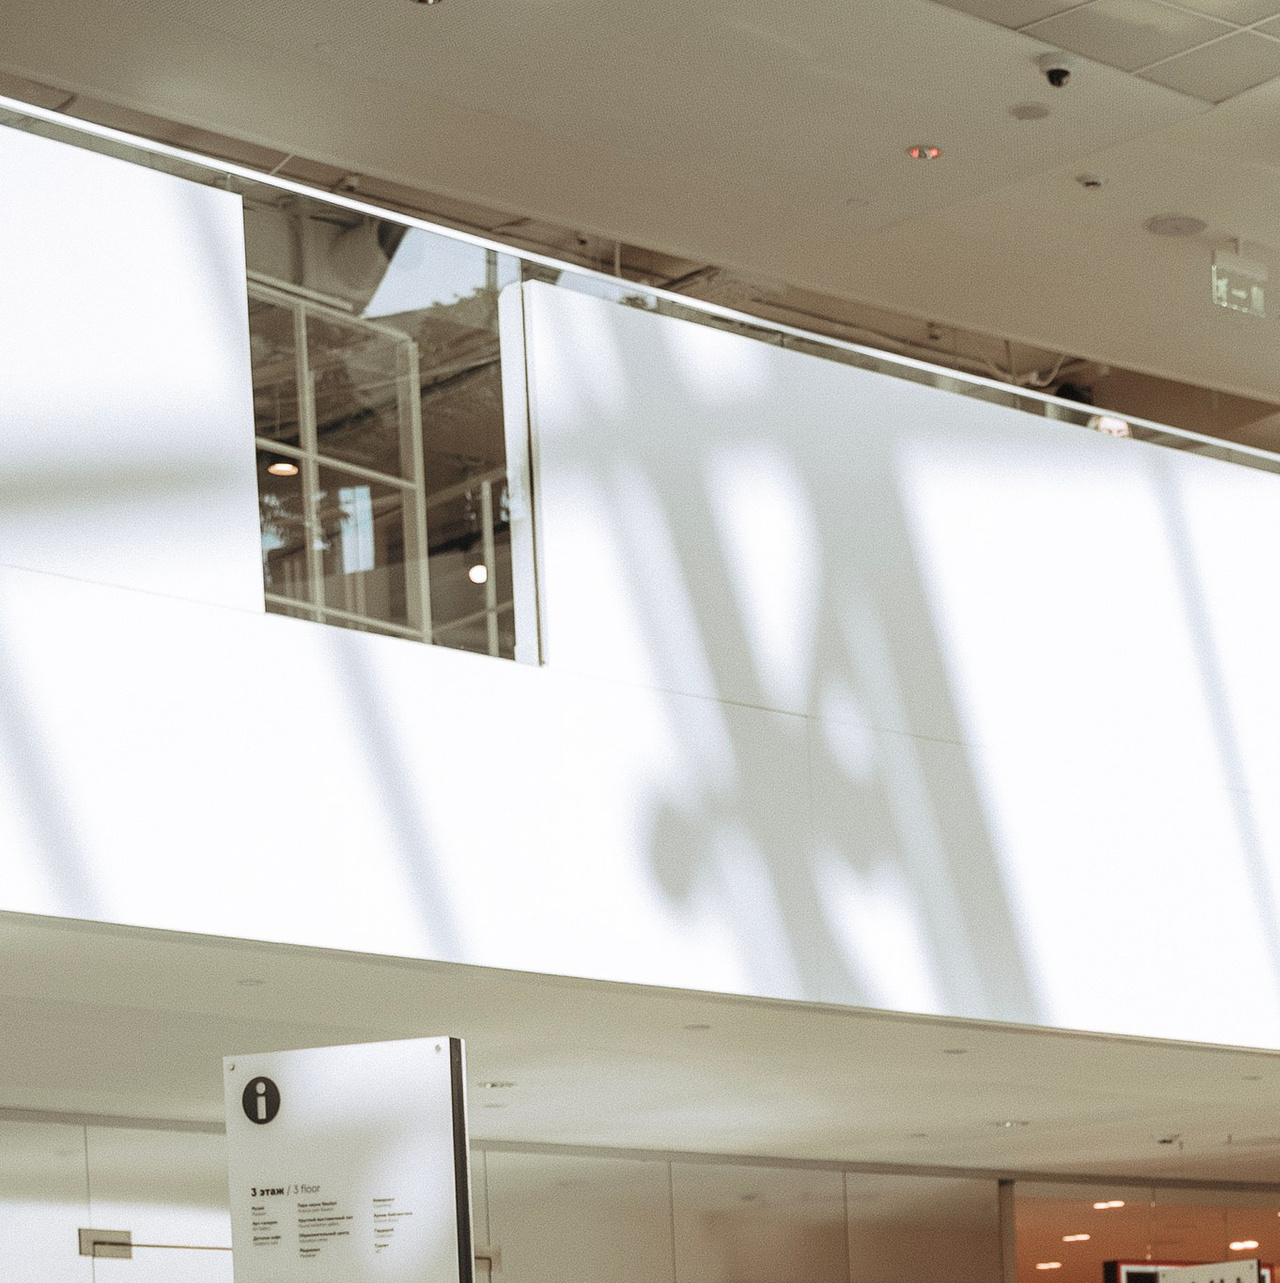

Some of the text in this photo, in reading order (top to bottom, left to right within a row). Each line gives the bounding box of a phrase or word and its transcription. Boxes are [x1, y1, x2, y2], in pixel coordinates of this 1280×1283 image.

[251, 1188, 257, 1196] 3
[260, 1188, 284, 1196] этаж
[301, 1184, 321, 1194] floor
